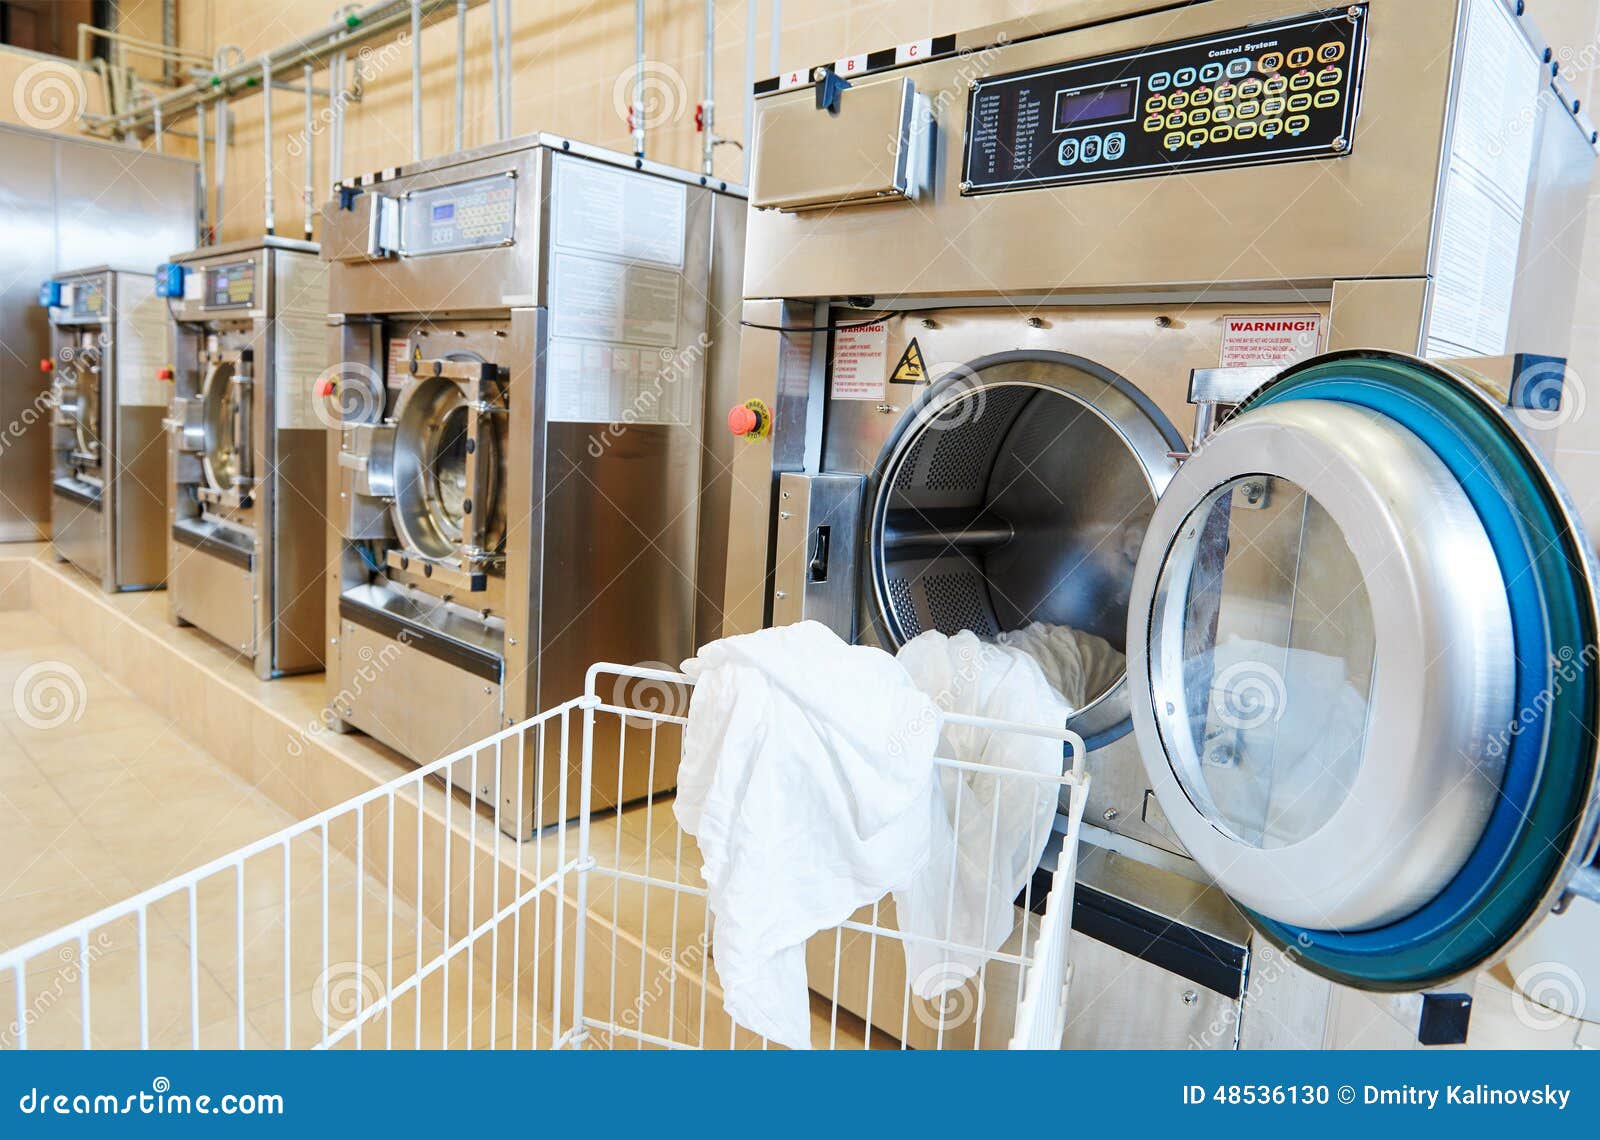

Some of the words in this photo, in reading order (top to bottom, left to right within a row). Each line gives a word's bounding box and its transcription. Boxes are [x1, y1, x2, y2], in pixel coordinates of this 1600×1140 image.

[910, 45, 917, 56] C
[1209, 46, 1242, 58] Control
[1245, 41, 1278, 51] System
[848, 60, 854, 70] B
[791, 73, 797, 82] A
[1230, 321, 1315, 331] WARNING!!
